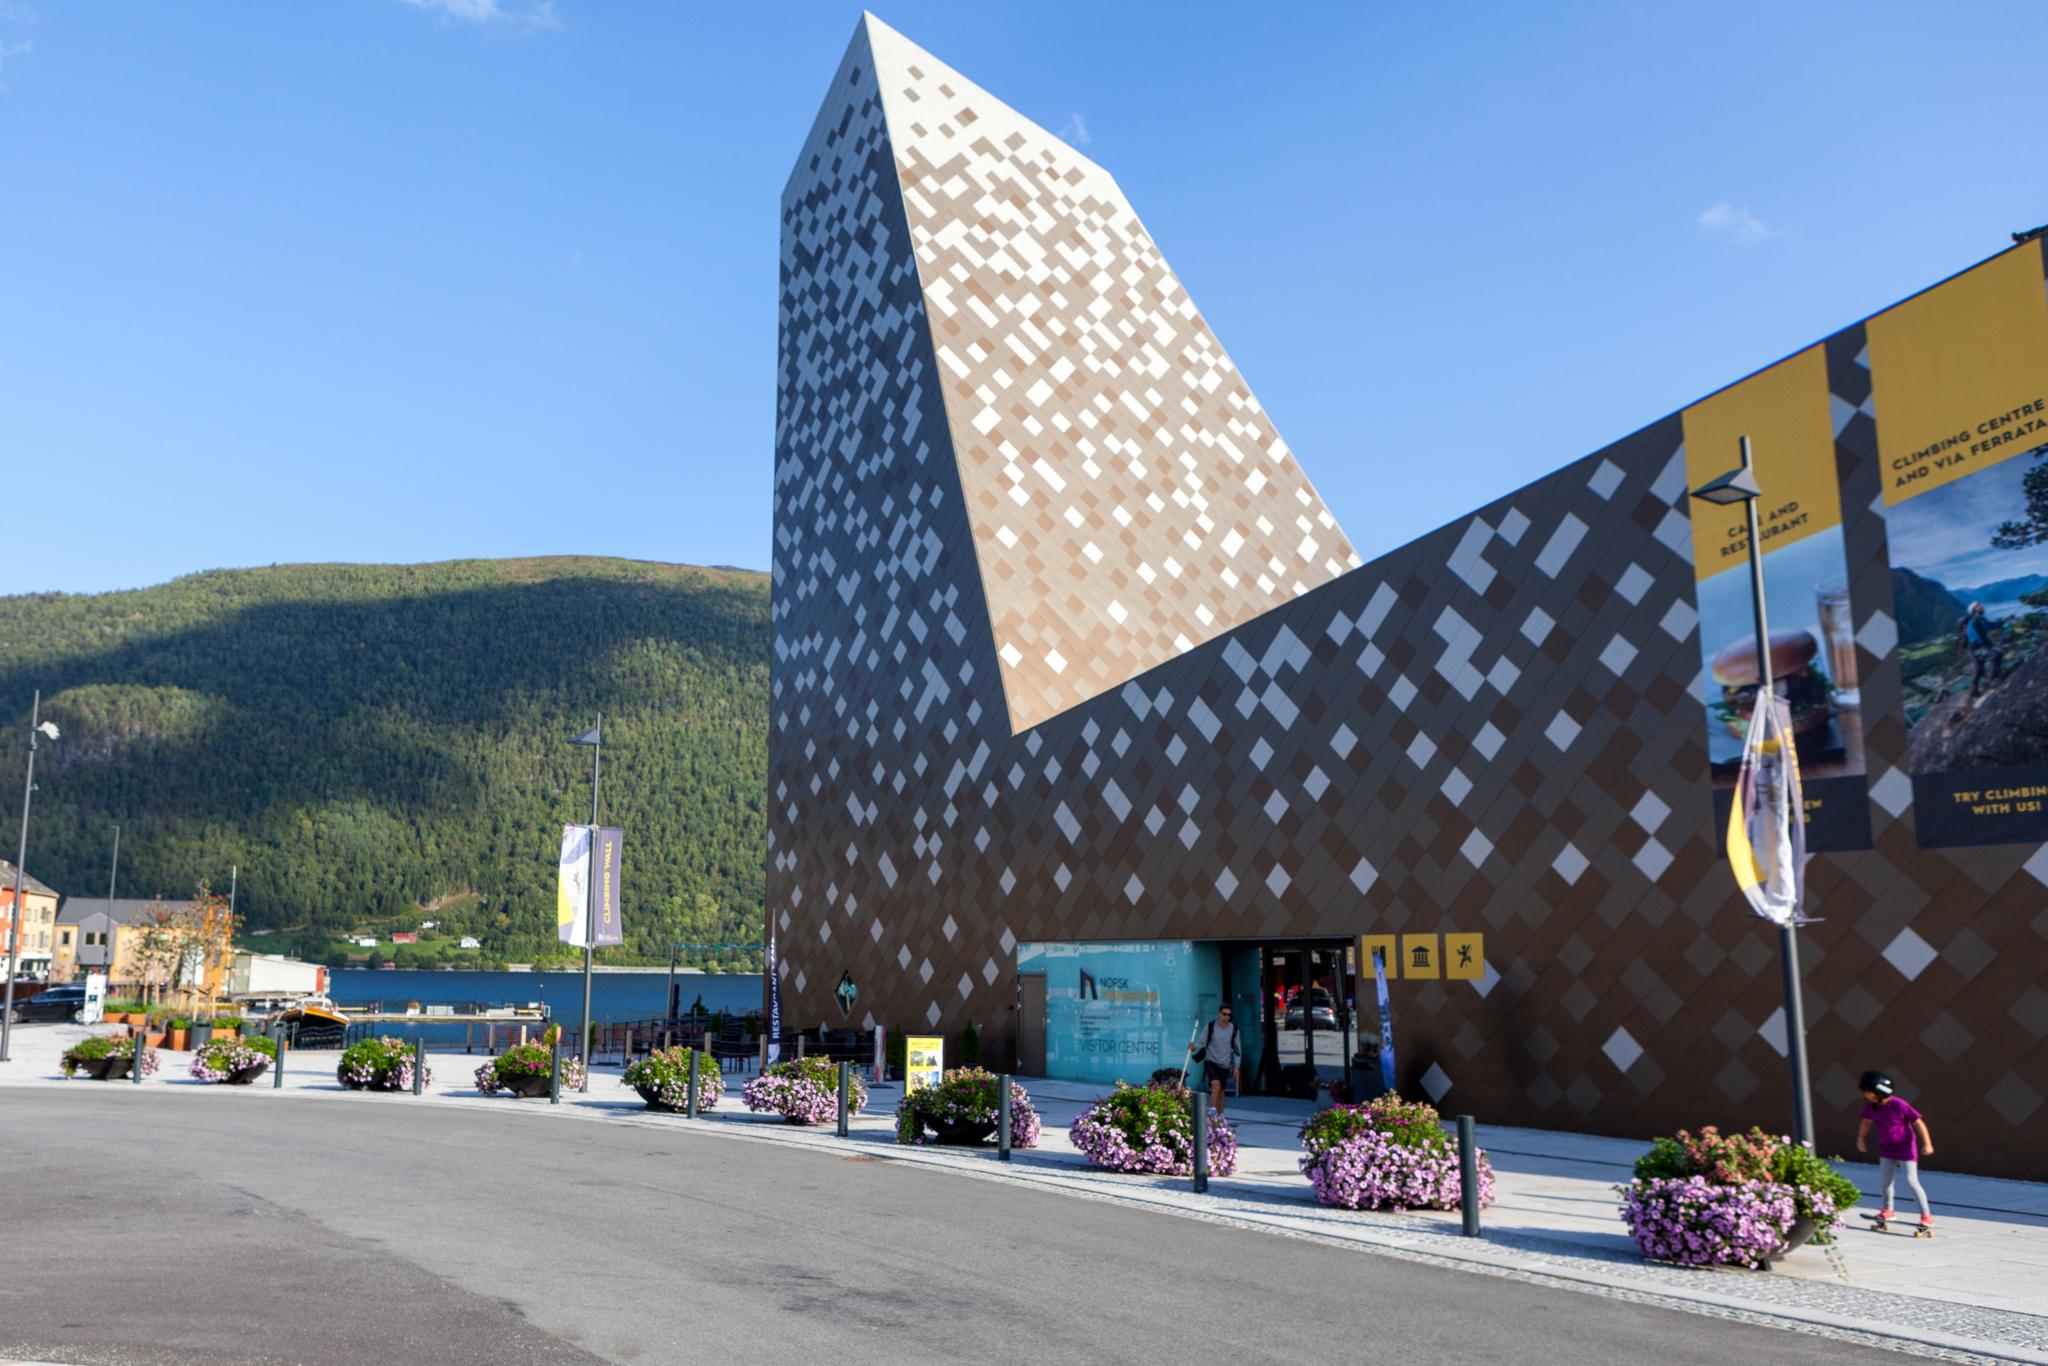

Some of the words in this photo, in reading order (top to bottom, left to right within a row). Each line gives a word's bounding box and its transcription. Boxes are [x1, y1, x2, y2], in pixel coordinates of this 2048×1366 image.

[1892, 431, 1971, 470] CLIMBING
[1977, 399, 2045, 434] CENTRE
[1896, 466, 1929, 488] AND
[1934, 453, 1965, 469] VIA
[1970, 418, 2048, 456] FERRATA
[1721, 512, 1808, 557] RESURANT
[1728, 513, 1763, 538] CAE
[1769, 502, 1799, 521] AND
[1953, 791, 1980, 803] TRY
[1985, 786, 2048, 800] CLIMBIN
[1972, 803, 2011, 815] WITH
[2016, 801, 2042, 812] US!
[604, 840, 613, 869] WALL
[603, 870, 612, 924] CLIMBING
[1080, 1039, 1116, 1053] VISITOR
[1119, 1040, 1160, 1056] CENTRE
